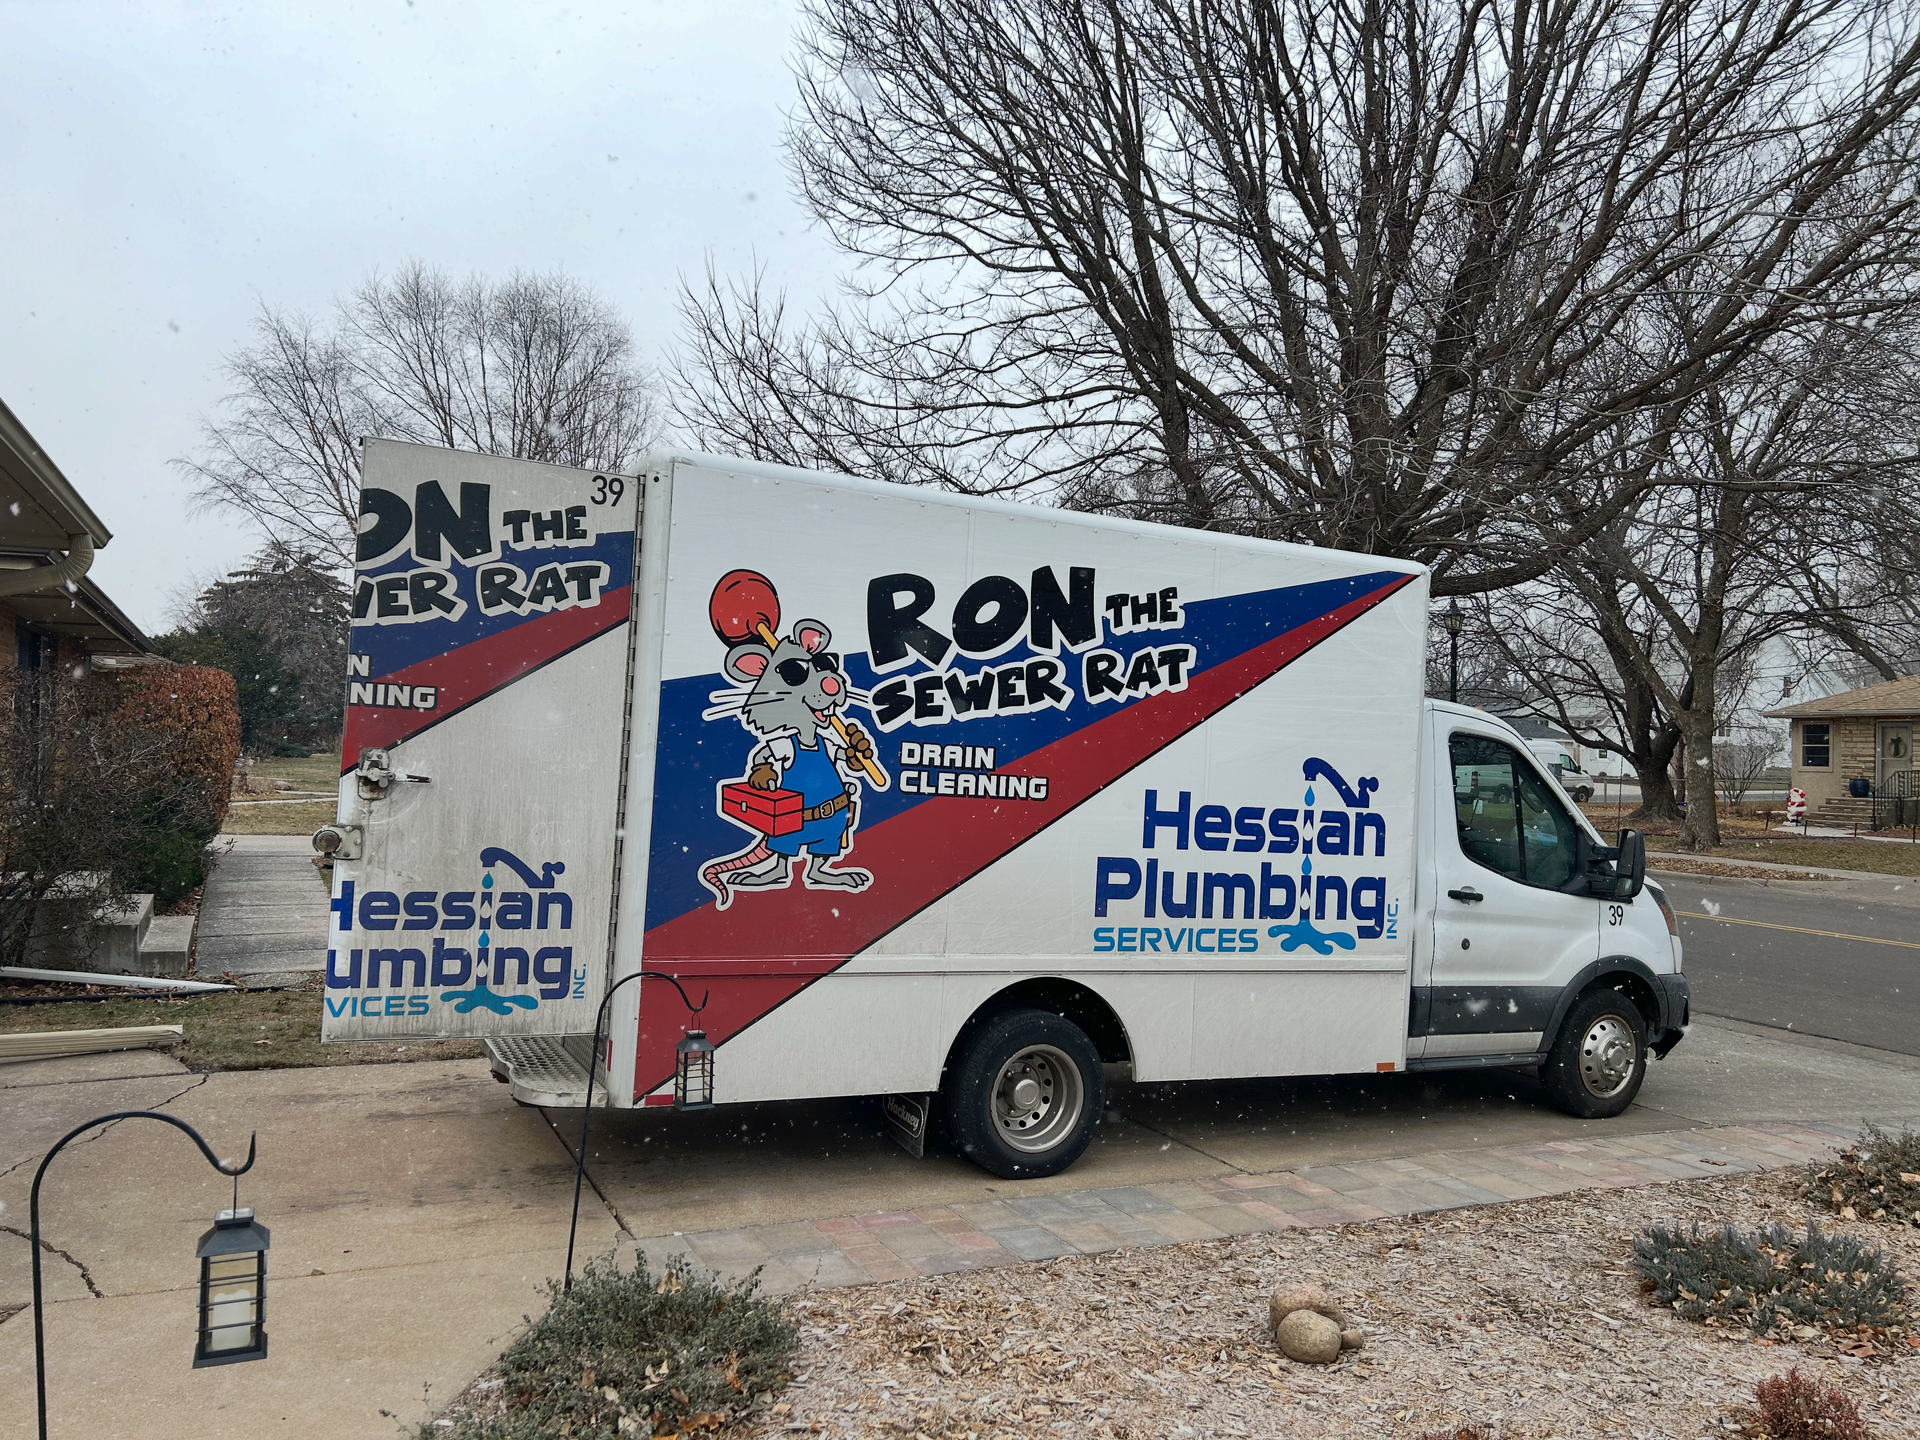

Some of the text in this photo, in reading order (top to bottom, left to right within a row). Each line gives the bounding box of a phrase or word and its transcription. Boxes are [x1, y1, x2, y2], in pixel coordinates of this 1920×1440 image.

[590, 475, 625, 507] 39
[503, 505, 588, 544] THE
[480, 565, 602, 609] RAT
[867, 565, 1179, 667] RON THE
[347, 653, 371, 677] N
[349, 681, 436, 709] NING
[872, 648, 1190, 726] SEWER RAT
[900, 741, 996, 771] DRAIN
[899, 770, 1048, 801] CLEANING
[1142, 786, 1387, 857] Hessian
[1094, 855, 1387, 940] Plumbing
[1608, 904, 1624, 926] 39
[1386, 897, 1399, 940] INC.
[1093, 927, 1259, 953] SERVICES
[325, 937, 573, 1000] umbing
[573, 963, 587, 1000] INC.
[324, 994, 430, 1018] VICES
